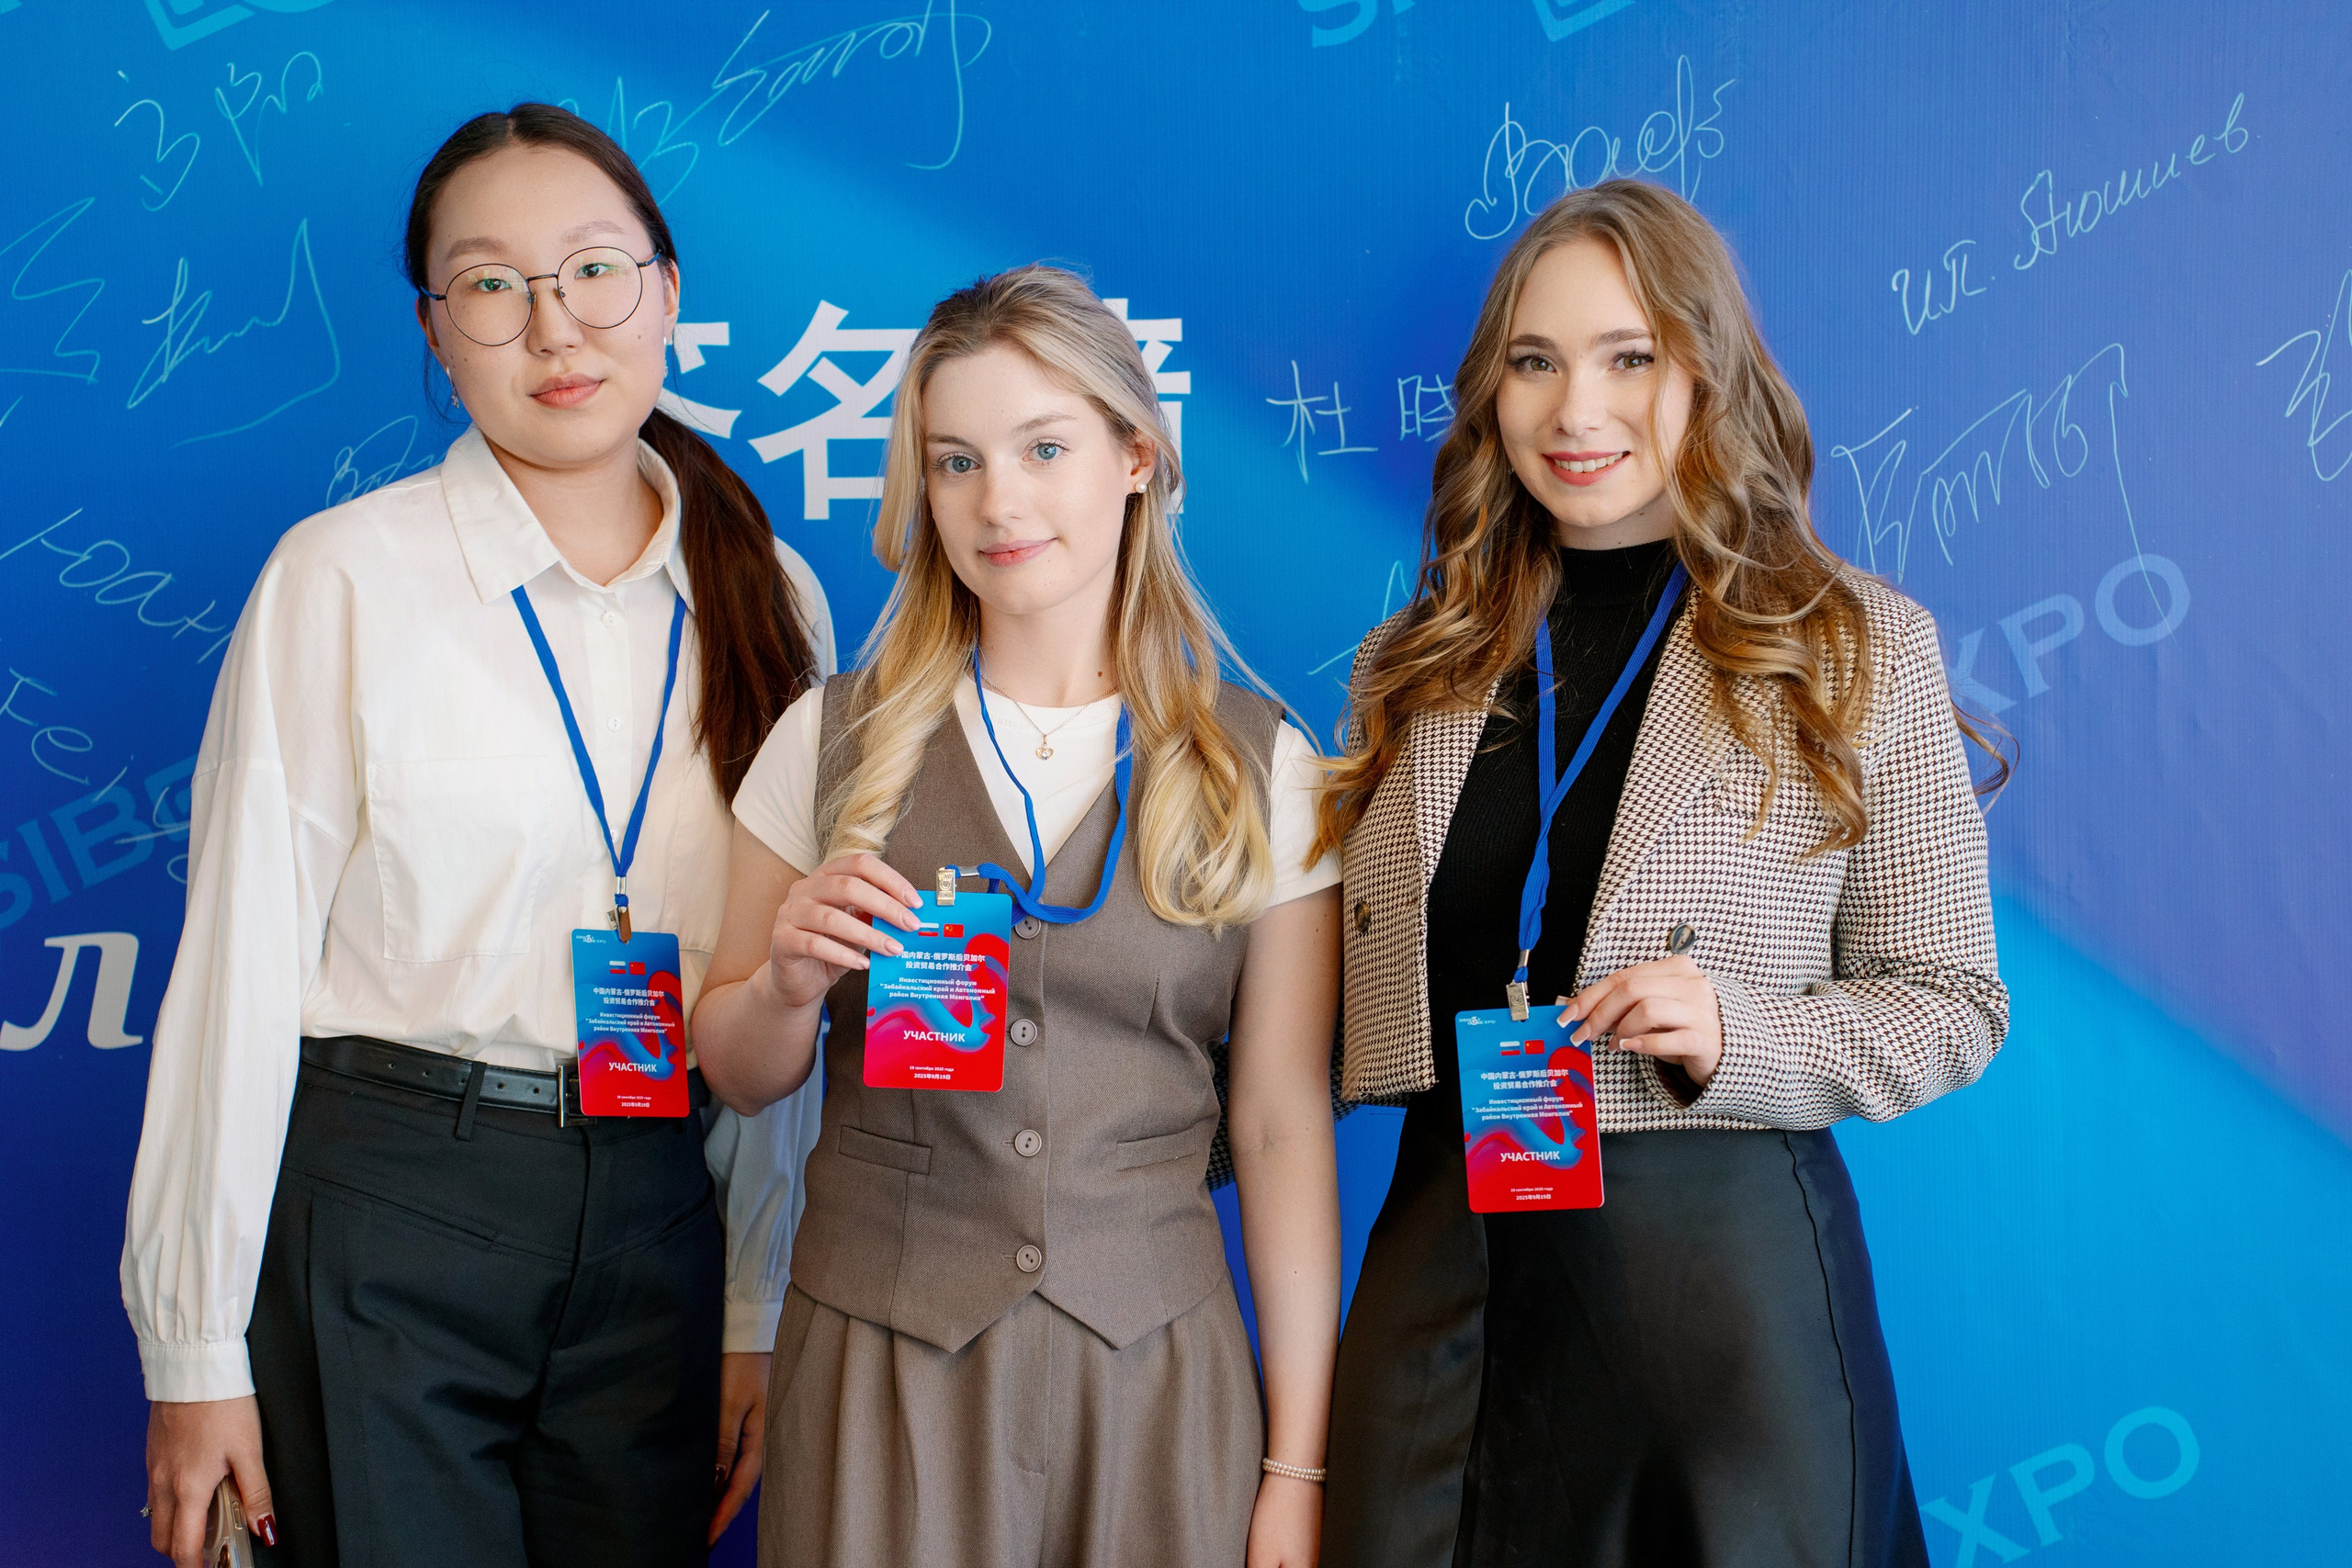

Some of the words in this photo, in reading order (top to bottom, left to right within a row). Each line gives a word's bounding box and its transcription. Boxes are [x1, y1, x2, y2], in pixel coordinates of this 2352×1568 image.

[897, 951, 985, 962] 国内蒙古-俄罗斯后贝加尔
[899, 977, 954, 986] Инвестиционный
[903, 1030, 965, 1042] УЧАСТНИК
[608, 1062, 657, 1072] УЧАСТНИК
[1489, 1096, 1542, 1104] Инвестиционный
[1500, 1151, 1560, 1162] УЧАСТНИК
